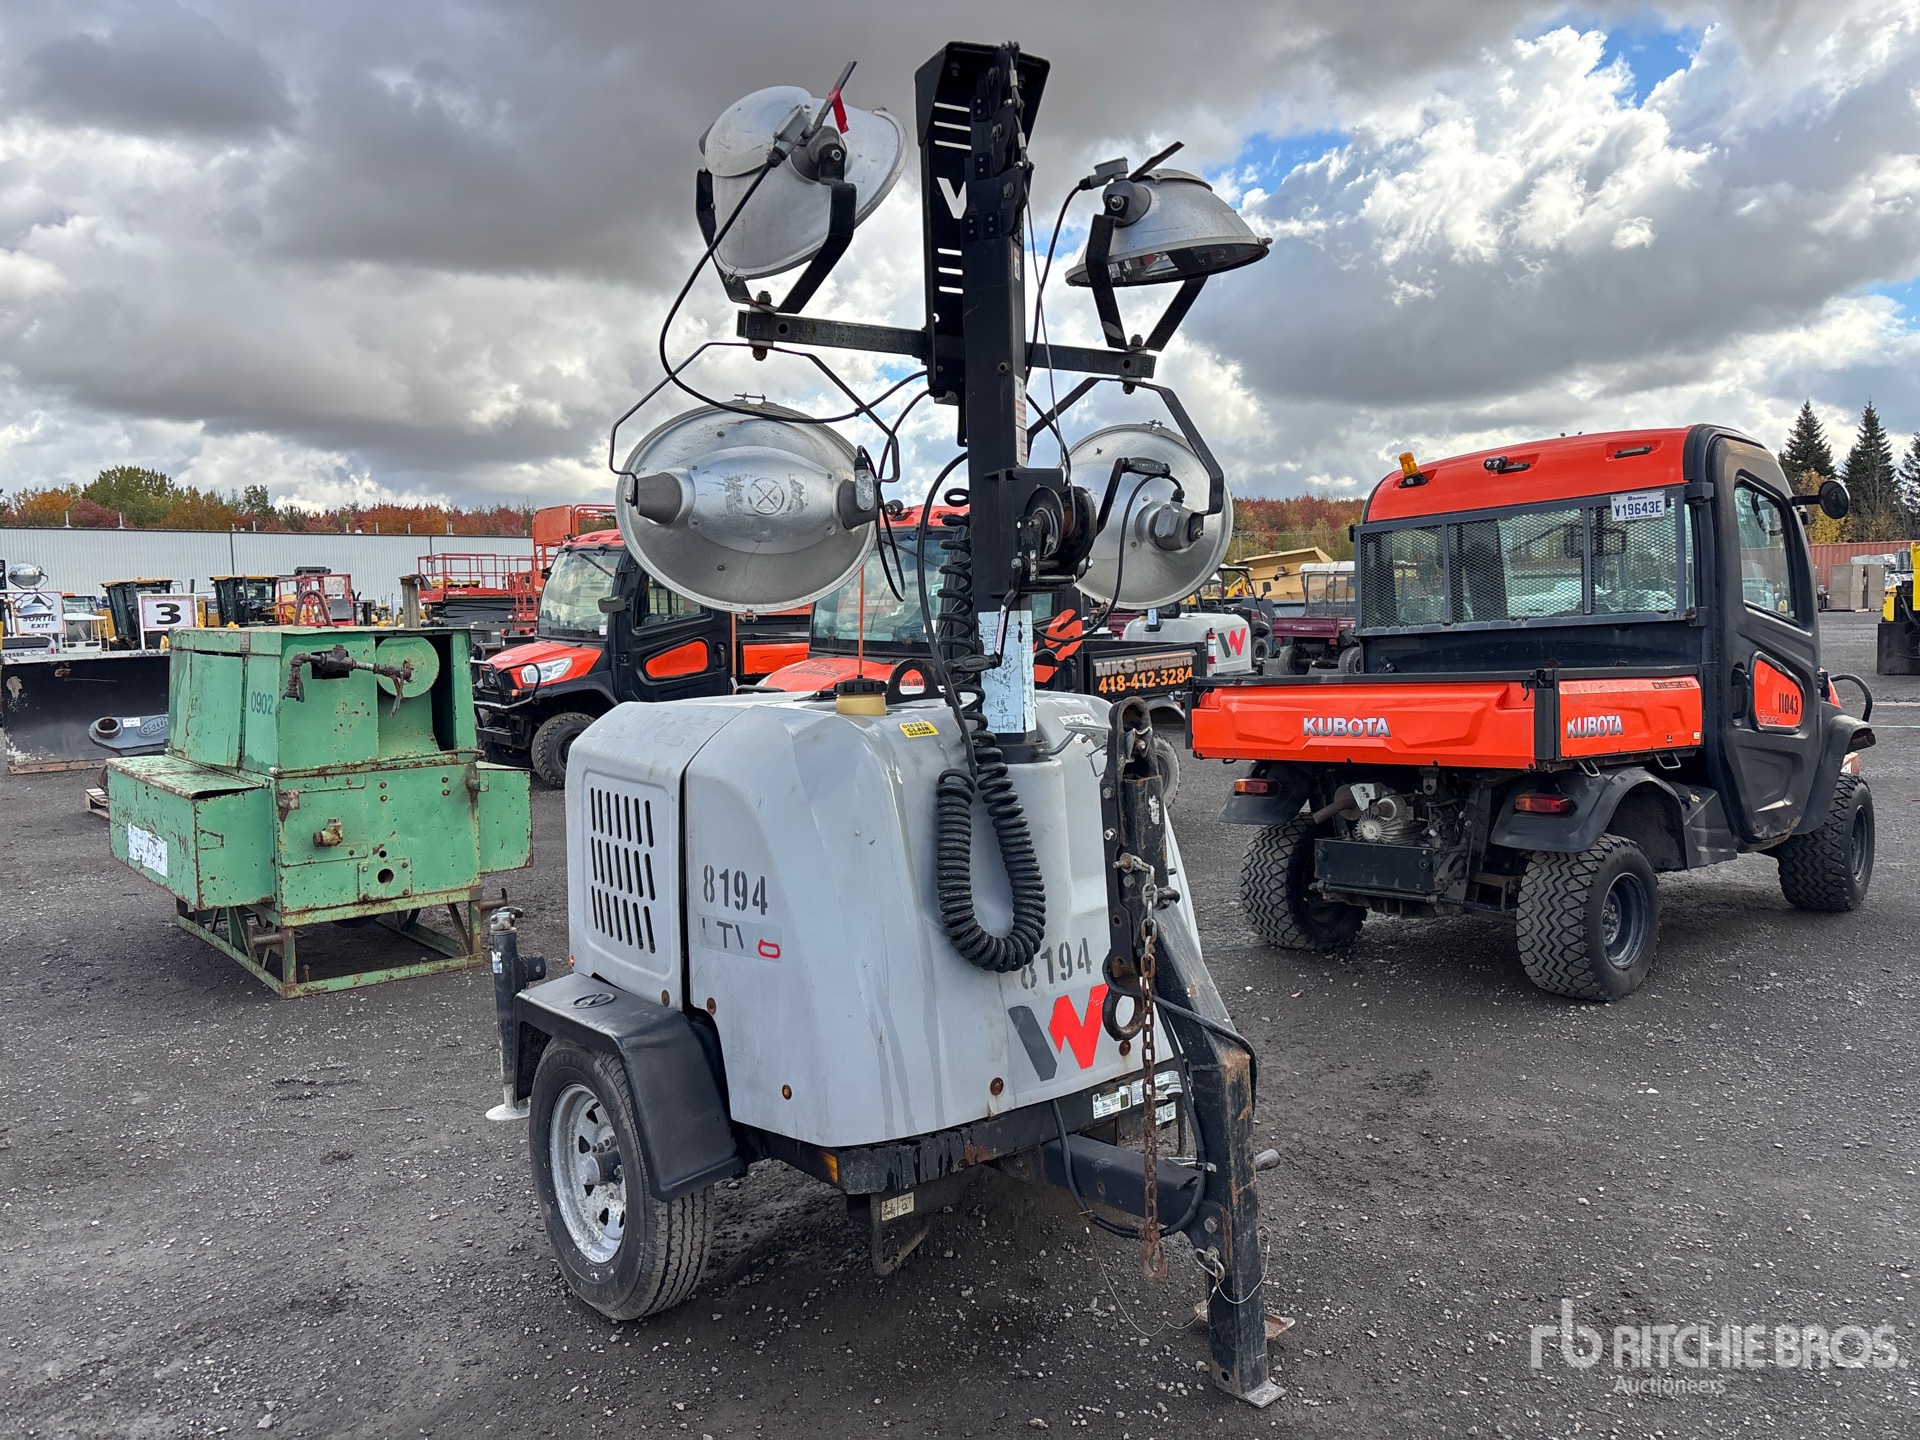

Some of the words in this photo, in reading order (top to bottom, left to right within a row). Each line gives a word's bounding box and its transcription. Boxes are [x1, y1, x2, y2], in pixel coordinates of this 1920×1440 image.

[1615, 501, 1662, 516] V19643E
[156, 603, 181, 624] 3
[1095, 659, 1136, 677] MKS
[1098, 667, 1193, 694] 418-412-3284
[1652, 680, 1694, 689] DIESEL
[251, 691, 274, 715] 0902
[1303, 717, 1391, 737] KUBOTA
[1567, 715, 1623, 738] KUBOTA
[703, 864, 768, 916] 8194
[1021, 937, 1093, 990] 8194
